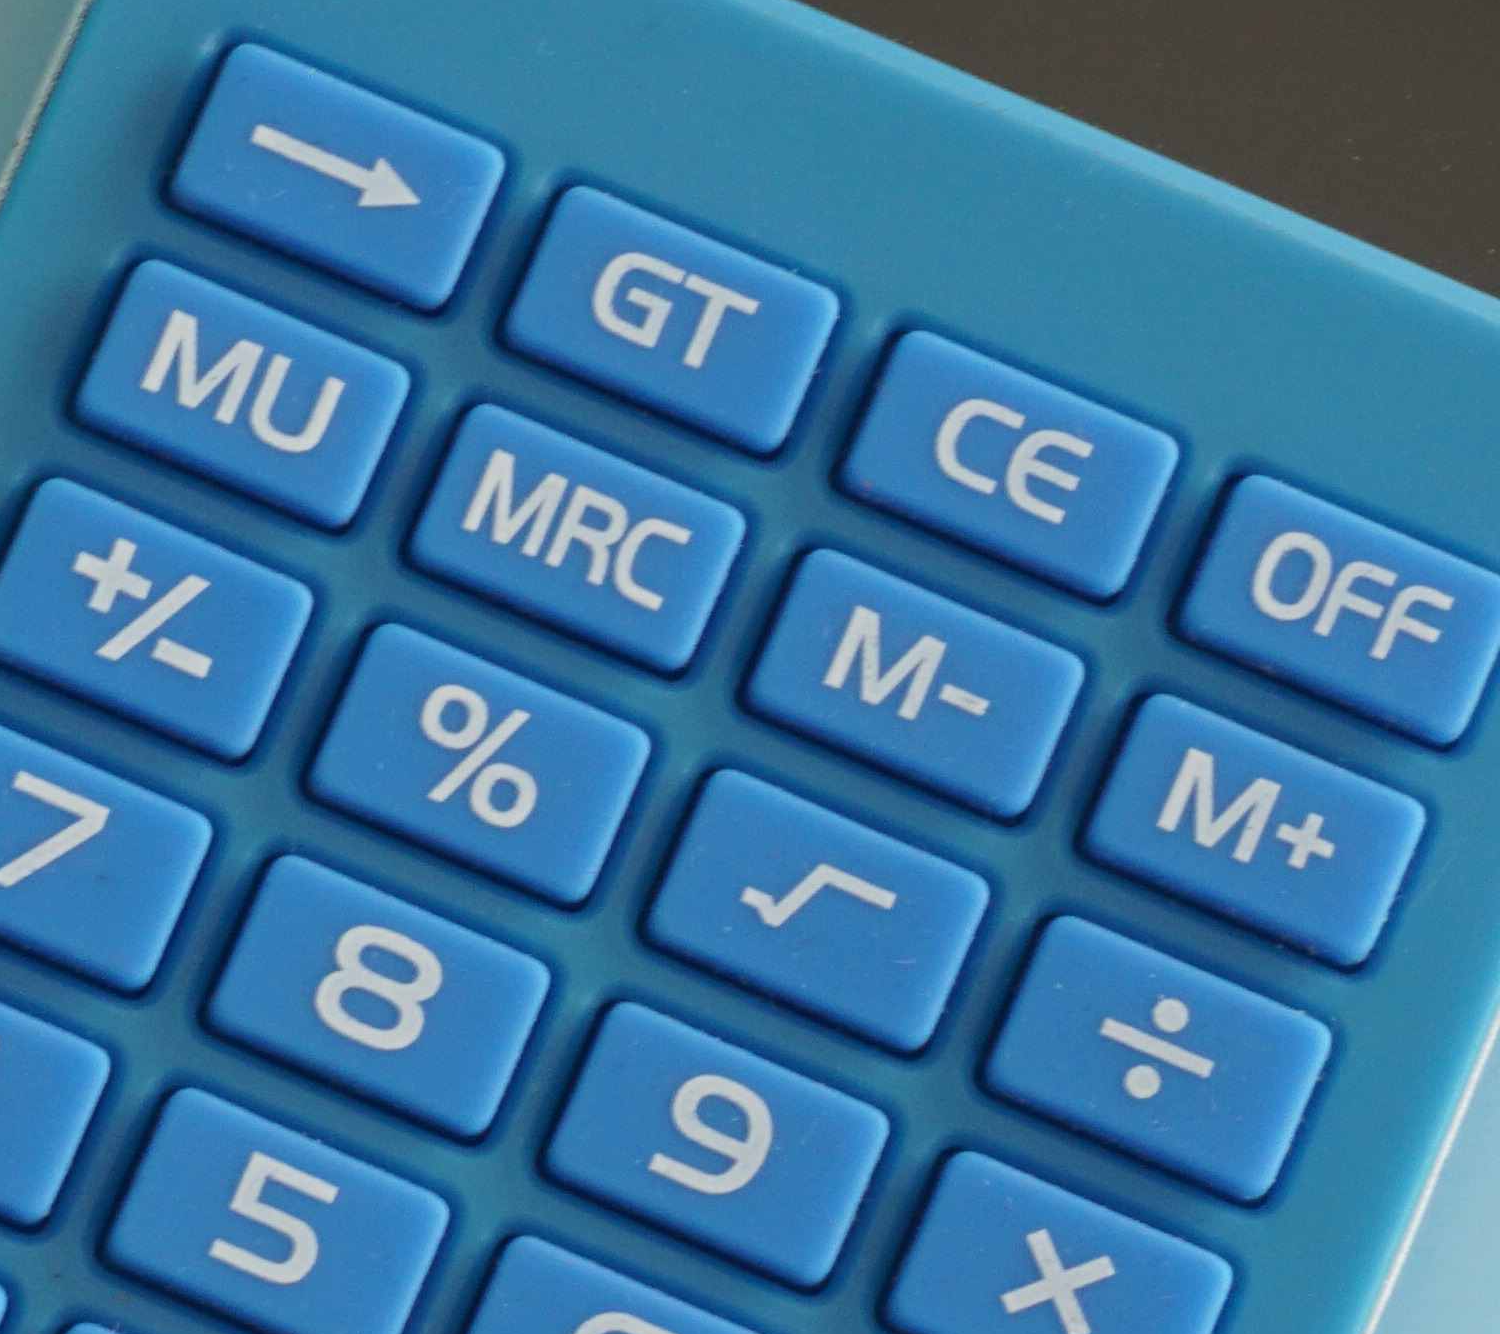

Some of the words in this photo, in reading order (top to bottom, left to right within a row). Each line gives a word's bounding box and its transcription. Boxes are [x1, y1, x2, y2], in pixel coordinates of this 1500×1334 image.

[592, 251, 759, 369] GT
[139, 309, 345, 454] MU
[935, 398, 1093, 525] CE
[462, 449, 692, 611] MRC
[1252, 530, 1454, 661] OFF
[823, 605, 990, 721] M-
[420, 684, 538, 829] %
[1156, 747, 1336, 871] M+
[313, 924, 443, 1052] 8
[648, 1074, 774, 1196] 9
[209, 1151, 339, 1287] 5
